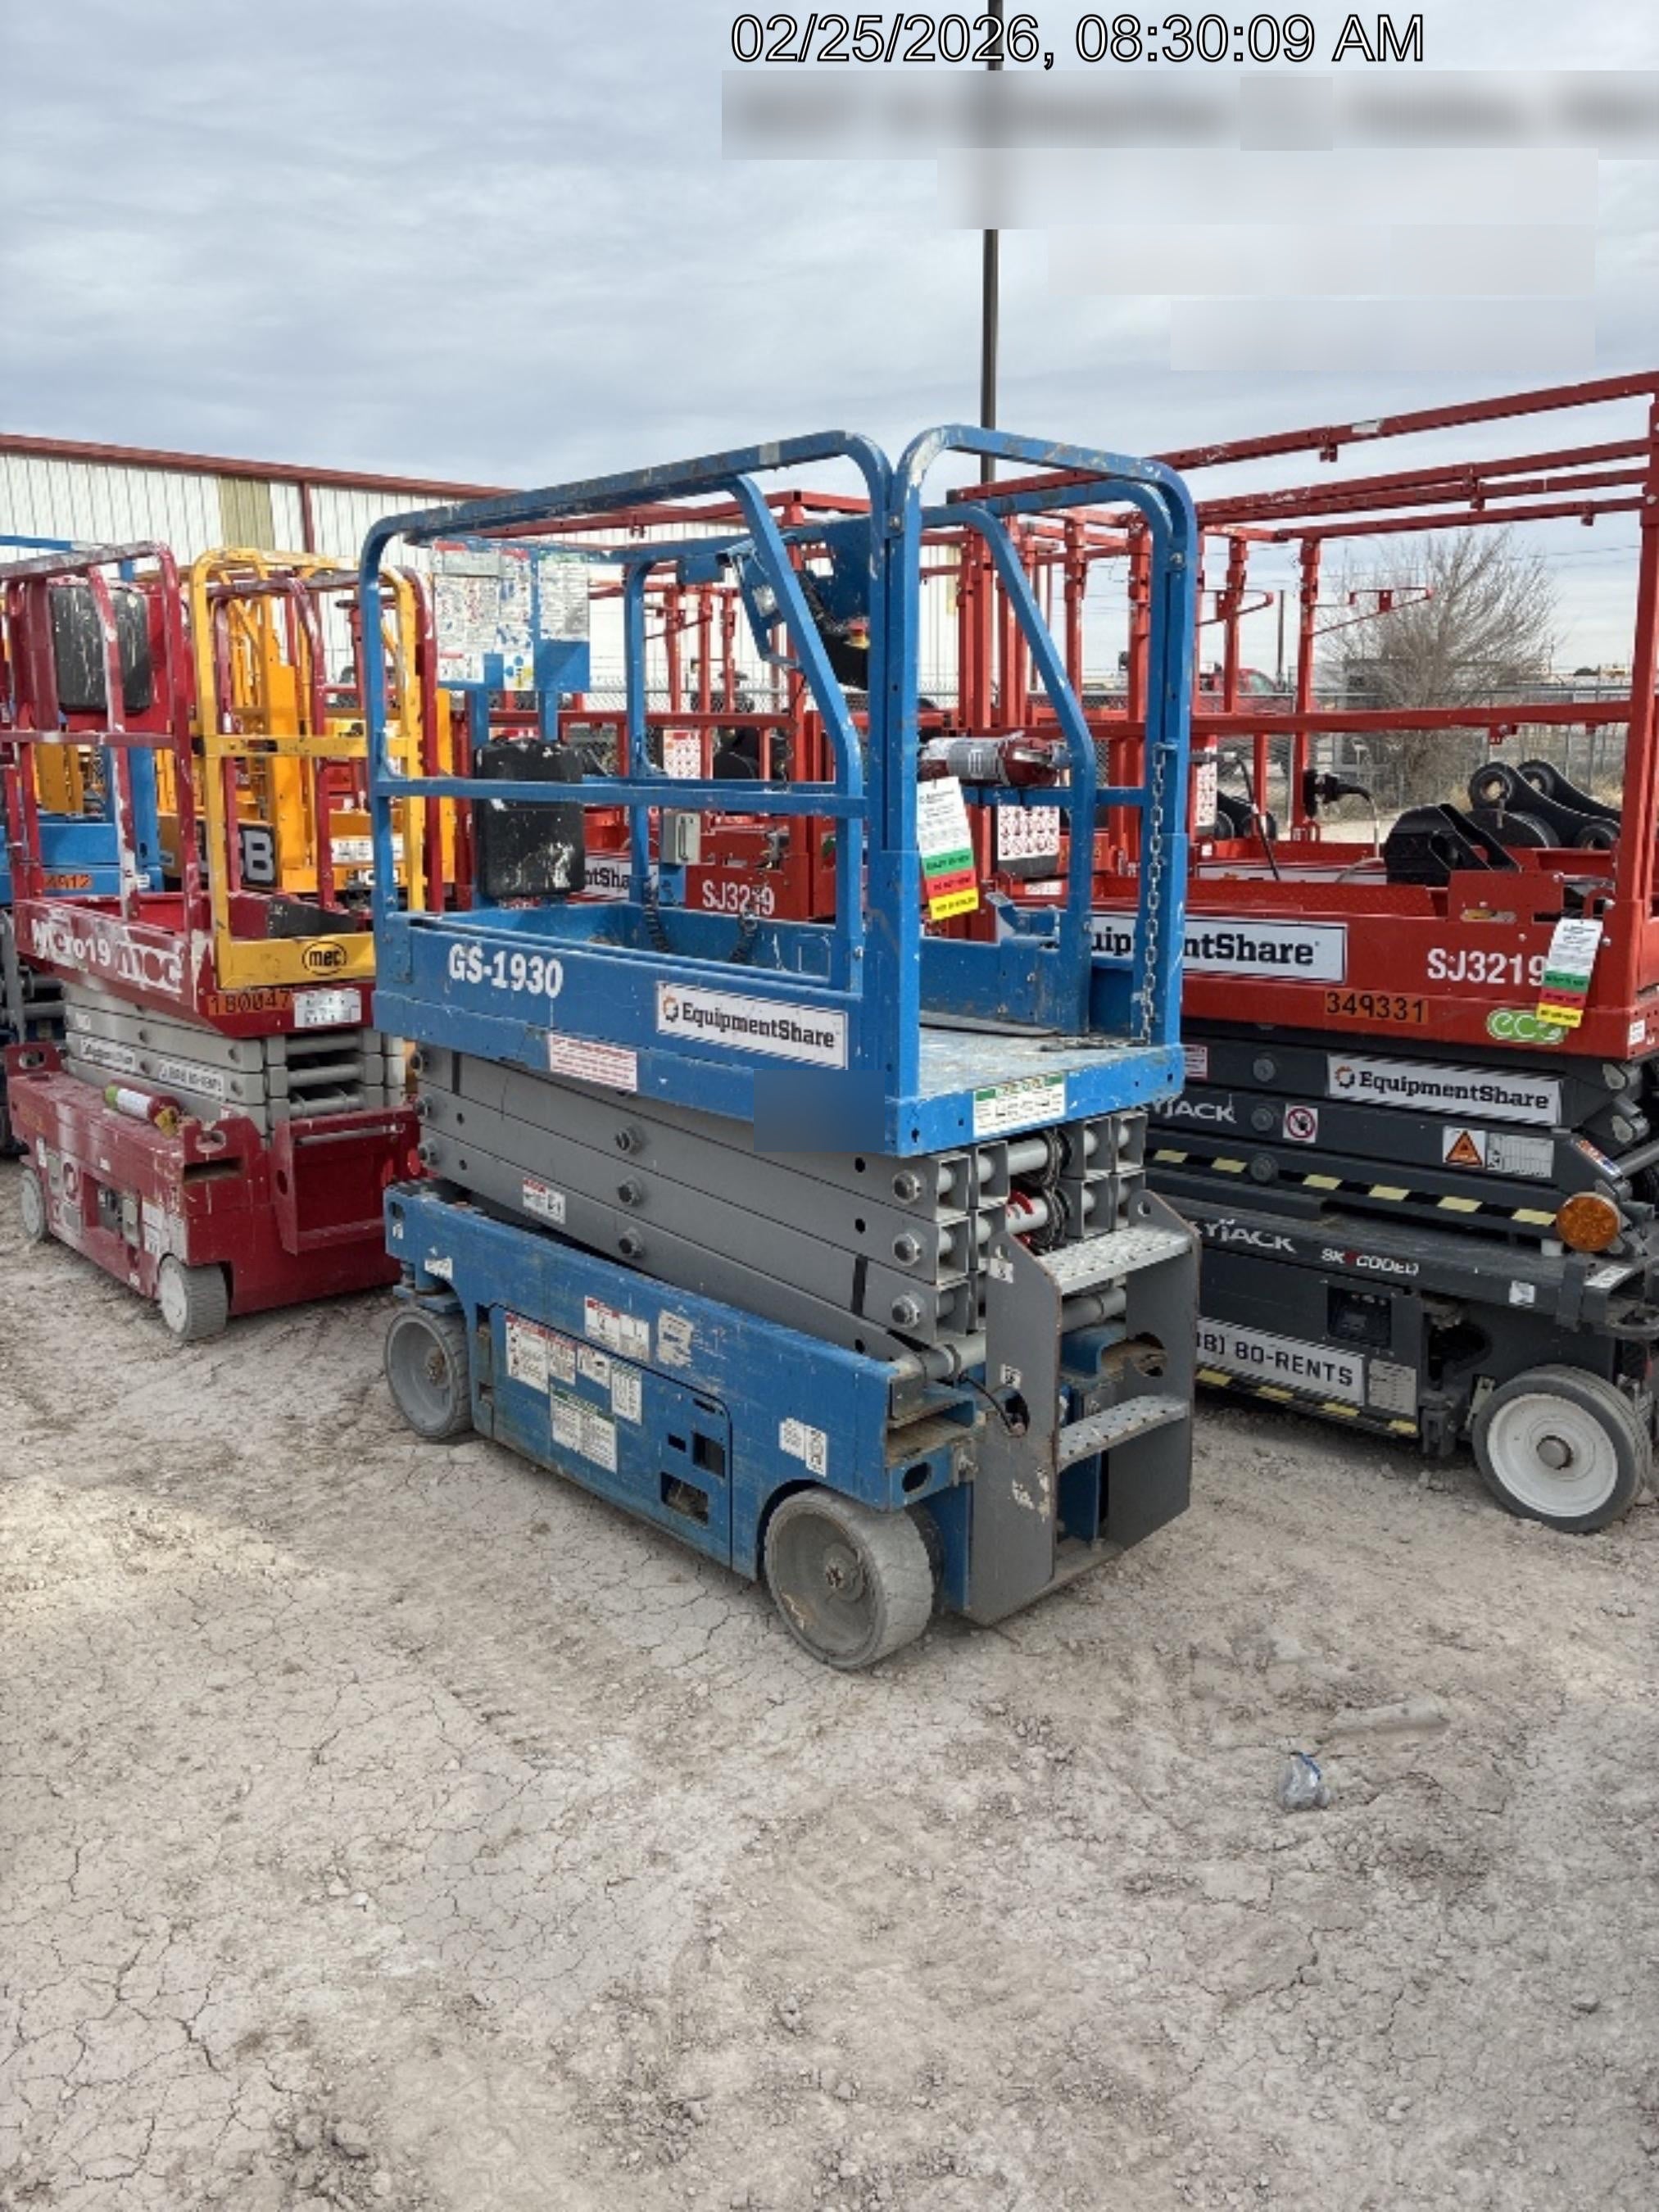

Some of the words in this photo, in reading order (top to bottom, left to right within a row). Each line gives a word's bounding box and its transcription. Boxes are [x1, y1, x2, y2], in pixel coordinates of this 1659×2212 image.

[309, 949, 342, 967] mec
[449, 942, 564, 999] GS-1930
[1426, 948, 1546, 987] SJ3219
[682, 1001, 836, 1049] EquipmentShare
[1326, 991, 1424, 1023] 349331
[1358, 1070, 1549, 1109] EquipmentShare
[1235, 1340, 1353, 1387] 80-RENTS
